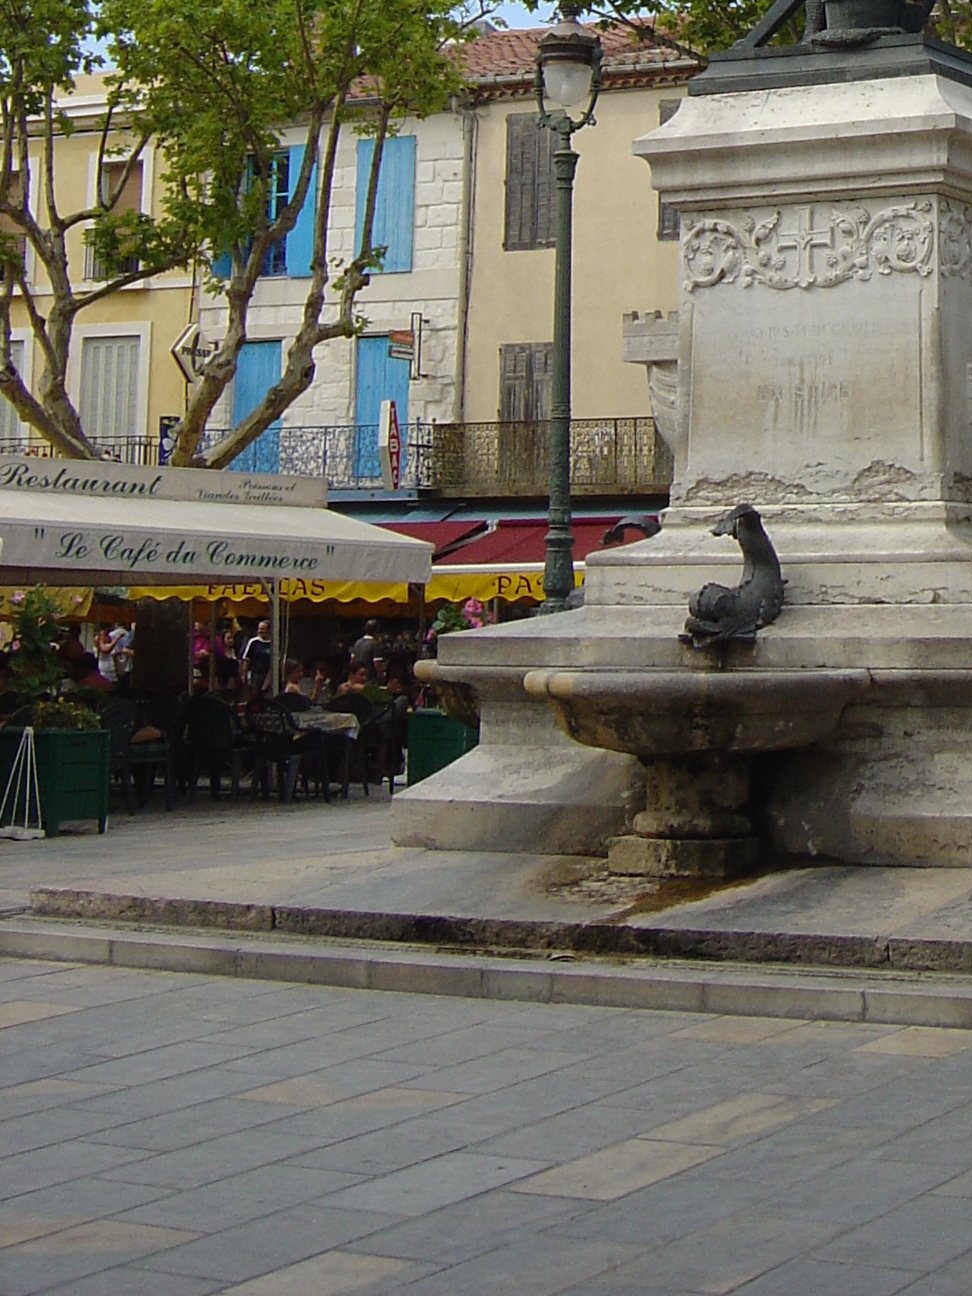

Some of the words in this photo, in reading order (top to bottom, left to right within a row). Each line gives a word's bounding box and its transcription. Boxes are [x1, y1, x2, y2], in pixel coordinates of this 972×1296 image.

[389, 407, 399, 484] TABAC
[0, 462, 163, 496] Restaurant
[55, 532, 92, 559] Le
[99, 534, 159, 569] Café
[166, 541, 197, 564] du
[206, 540, 320, 571] Commerce
